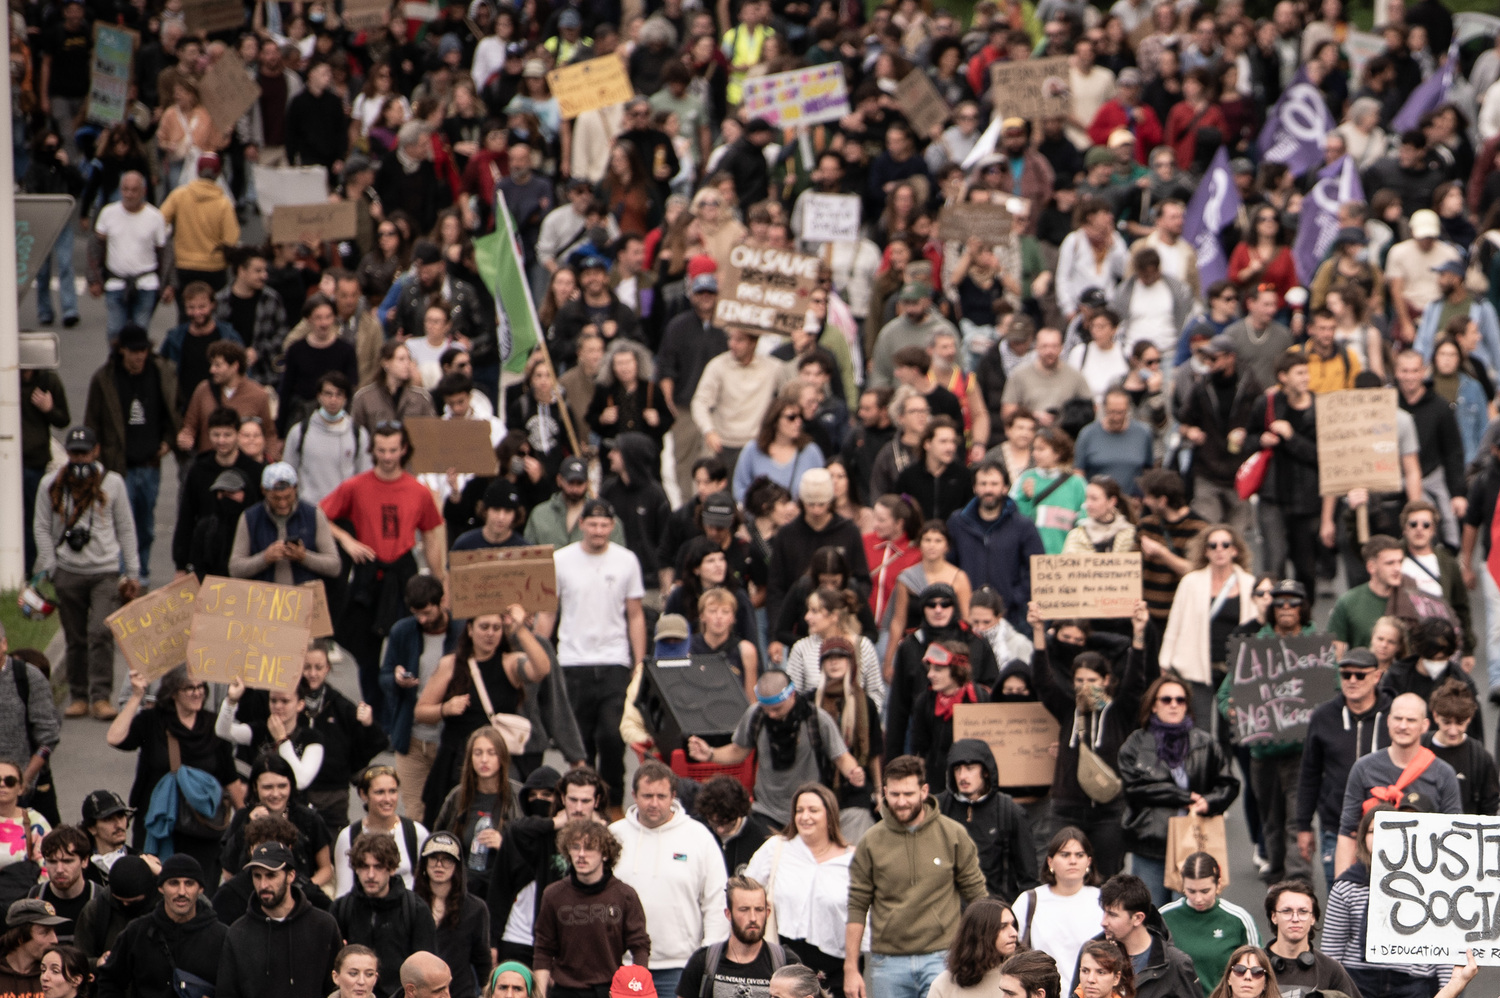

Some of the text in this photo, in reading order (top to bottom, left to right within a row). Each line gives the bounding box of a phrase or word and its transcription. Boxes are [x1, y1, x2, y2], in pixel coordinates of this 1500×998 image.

[112, 588, 195, 640] JEUNES
[226, 620, 278, 648] DONC
[1380, 943, 1450, 957] D'EDUCATION
[628, 977, 643, 992] cgt
[715, 974, 746, 983] MOUNTAIN
